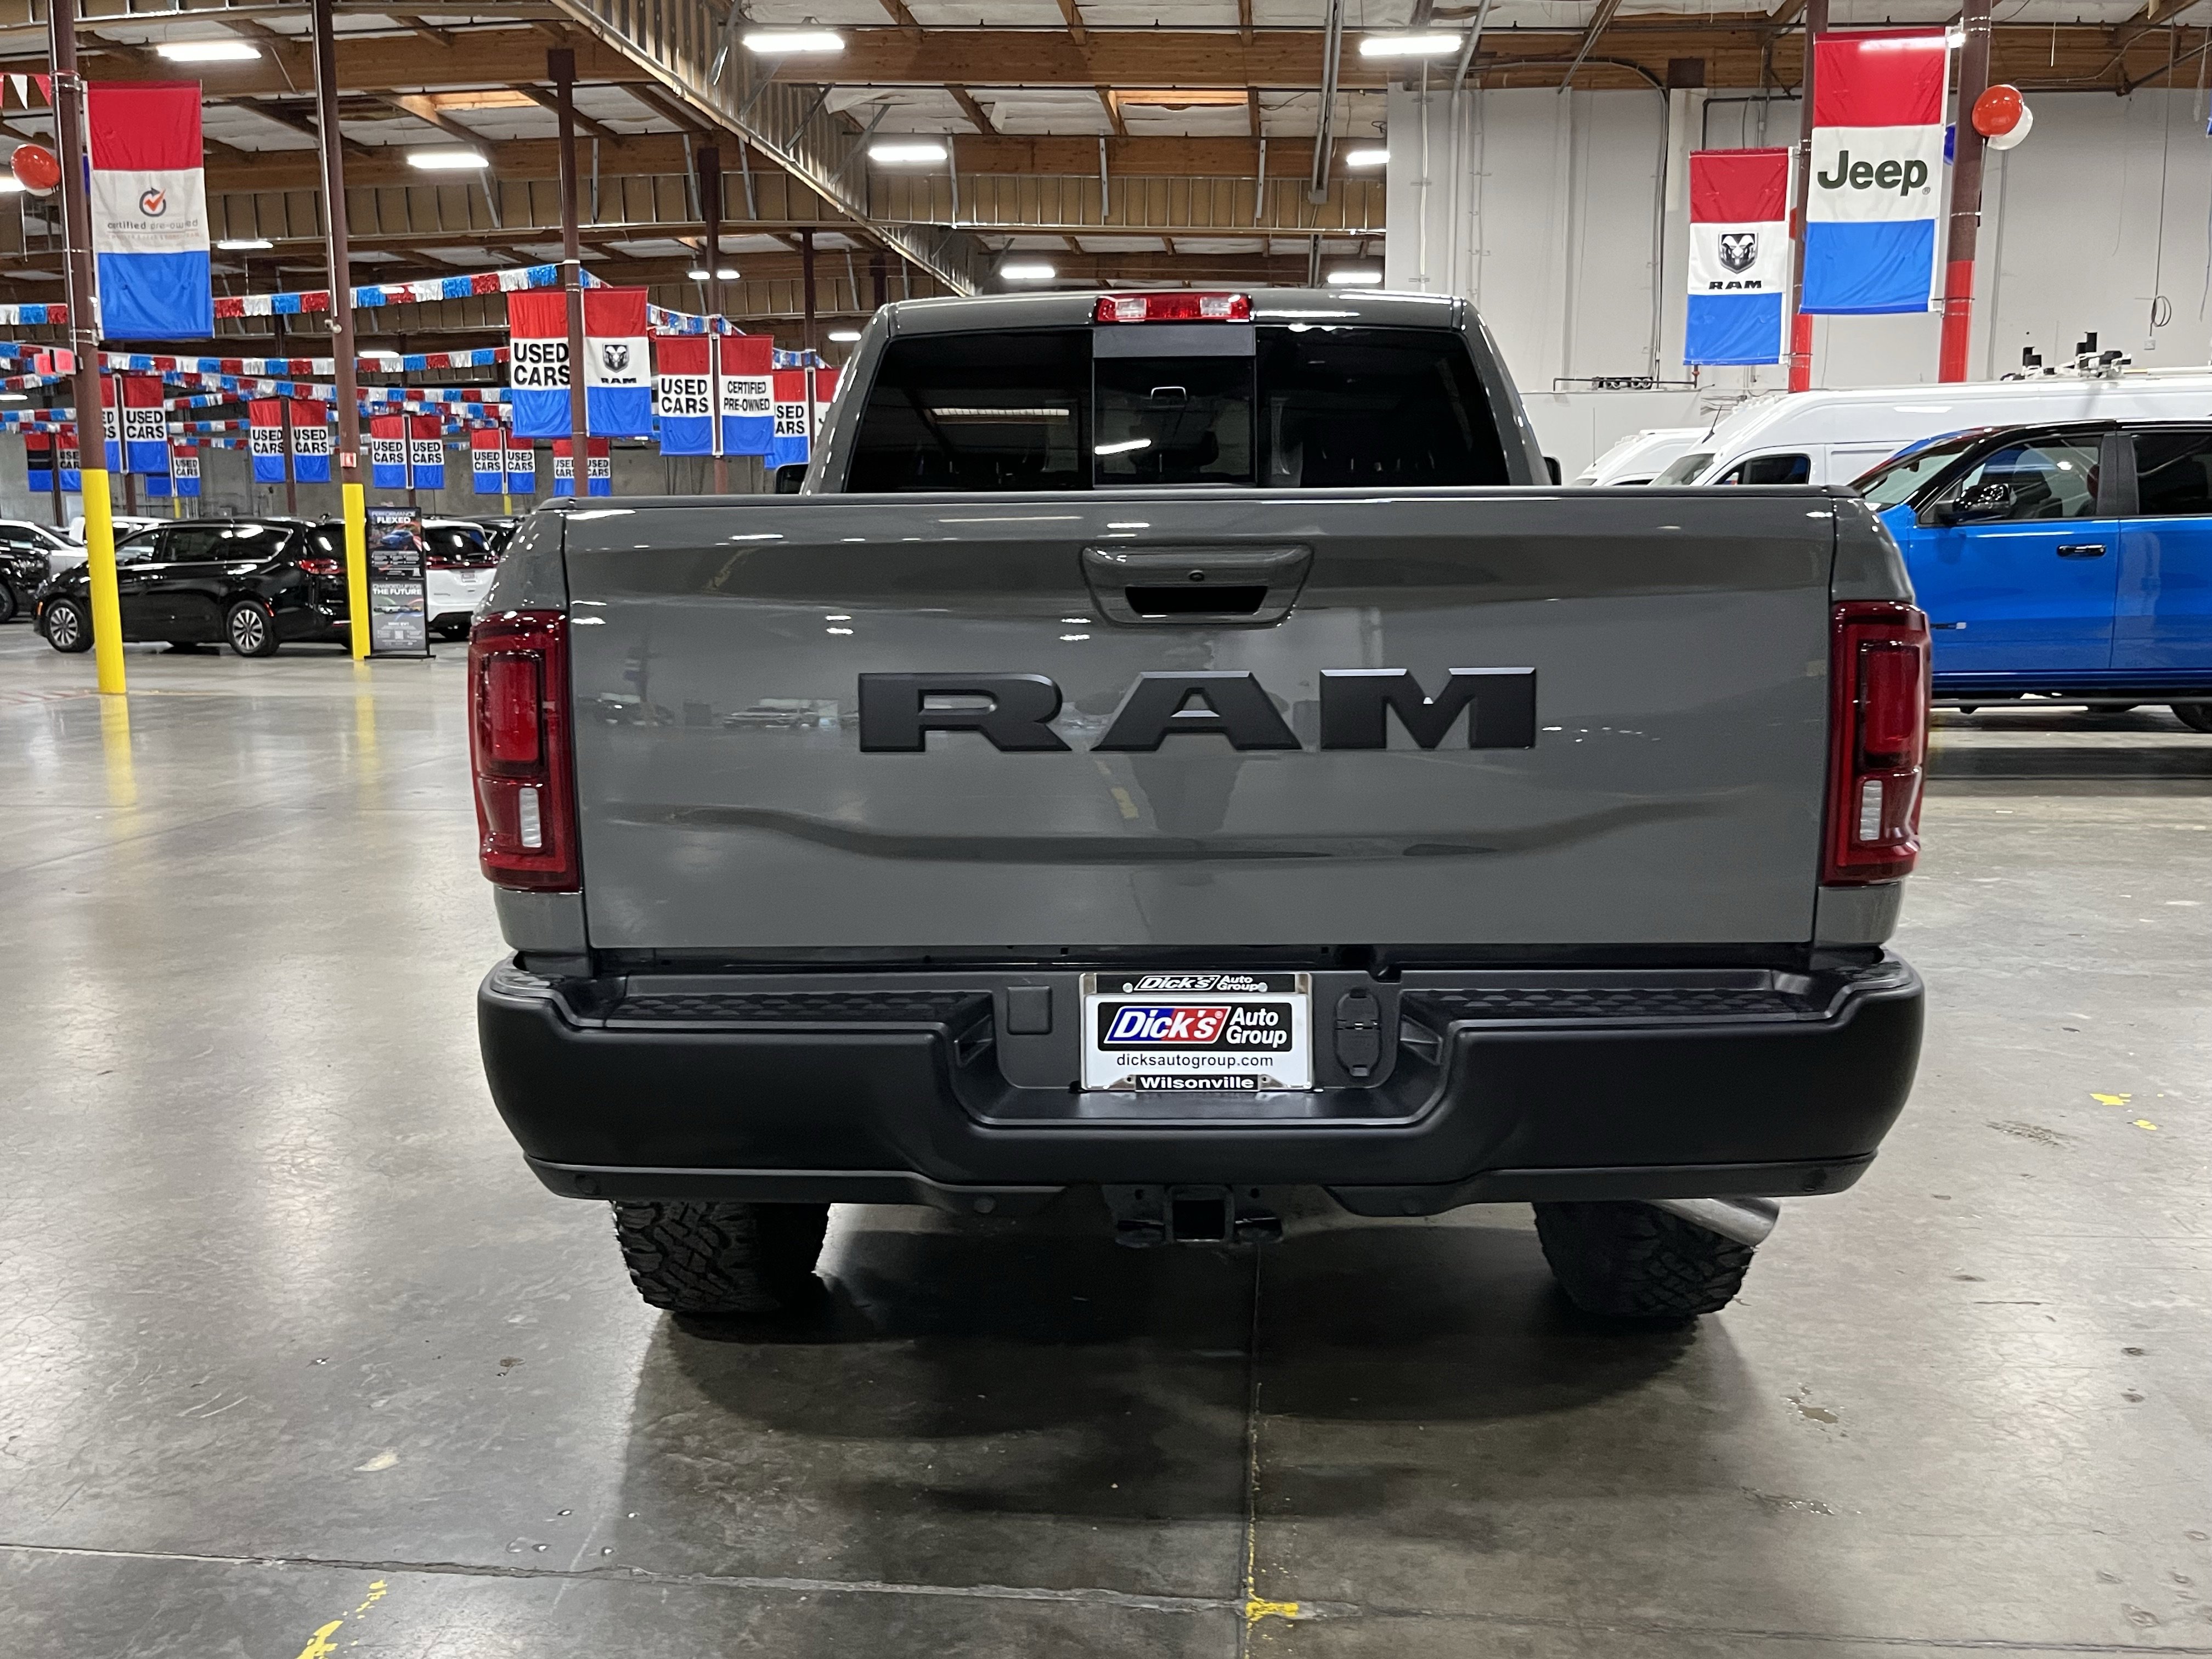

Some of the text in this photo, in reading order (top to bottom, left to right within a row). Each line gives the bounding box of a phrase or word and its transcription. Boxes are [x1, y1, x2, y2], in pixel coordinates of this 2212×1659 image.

[1818, 150, 1928, 196] Jeep
[1708, 280, 1762, 290] RAM
[514, 342, 569, 364] USED
[514, 365, 570, 386] CARS
[661, 378, 707, 395] USED
[727, 381, 766, 394] CERTIFIED
[662, 397, 709, 414] CARS
[724, 397, 770, 411] PRE-OWNED
[126, 410, 163, 424] USED
[777, 405, 804, 419] SED
[126, 426, 164, 438] CARS
[776, 420, 805, 434] ARS
[252, 430, 283, 441] USED
[294, 429, 327, 441] USED
[253, 442, 284, 454] CARS
[295, 442, 328, 453] CARS
[373, 441, 403, 452] USED
[413, 442, 442, 452] USED
[60, 451, 79, 460] USE
[374, 453, 404, 463] CARS
[413, 454, 442, 464] CARS
[475, 452, 500, 461] USED
[508, 452, 533, 461] USED
[176, 468, 198, 476] CARS
[475, 462, 501, 471] CARS
[507, 462, 533, 471] CARS
[859, 667, 1536, 752] RAM
[1220, 975, 1253, 984] Auto
[1217, 983, 1259, 991] Group
[1230, 1007, 1279, 1026] Auto
[1226, 1026, 1287, 1048] Group
[1117, 1053, 1273, 1068] dicksautogroup.com
[1140, 1077, 1254, 1089] Wilsonville
